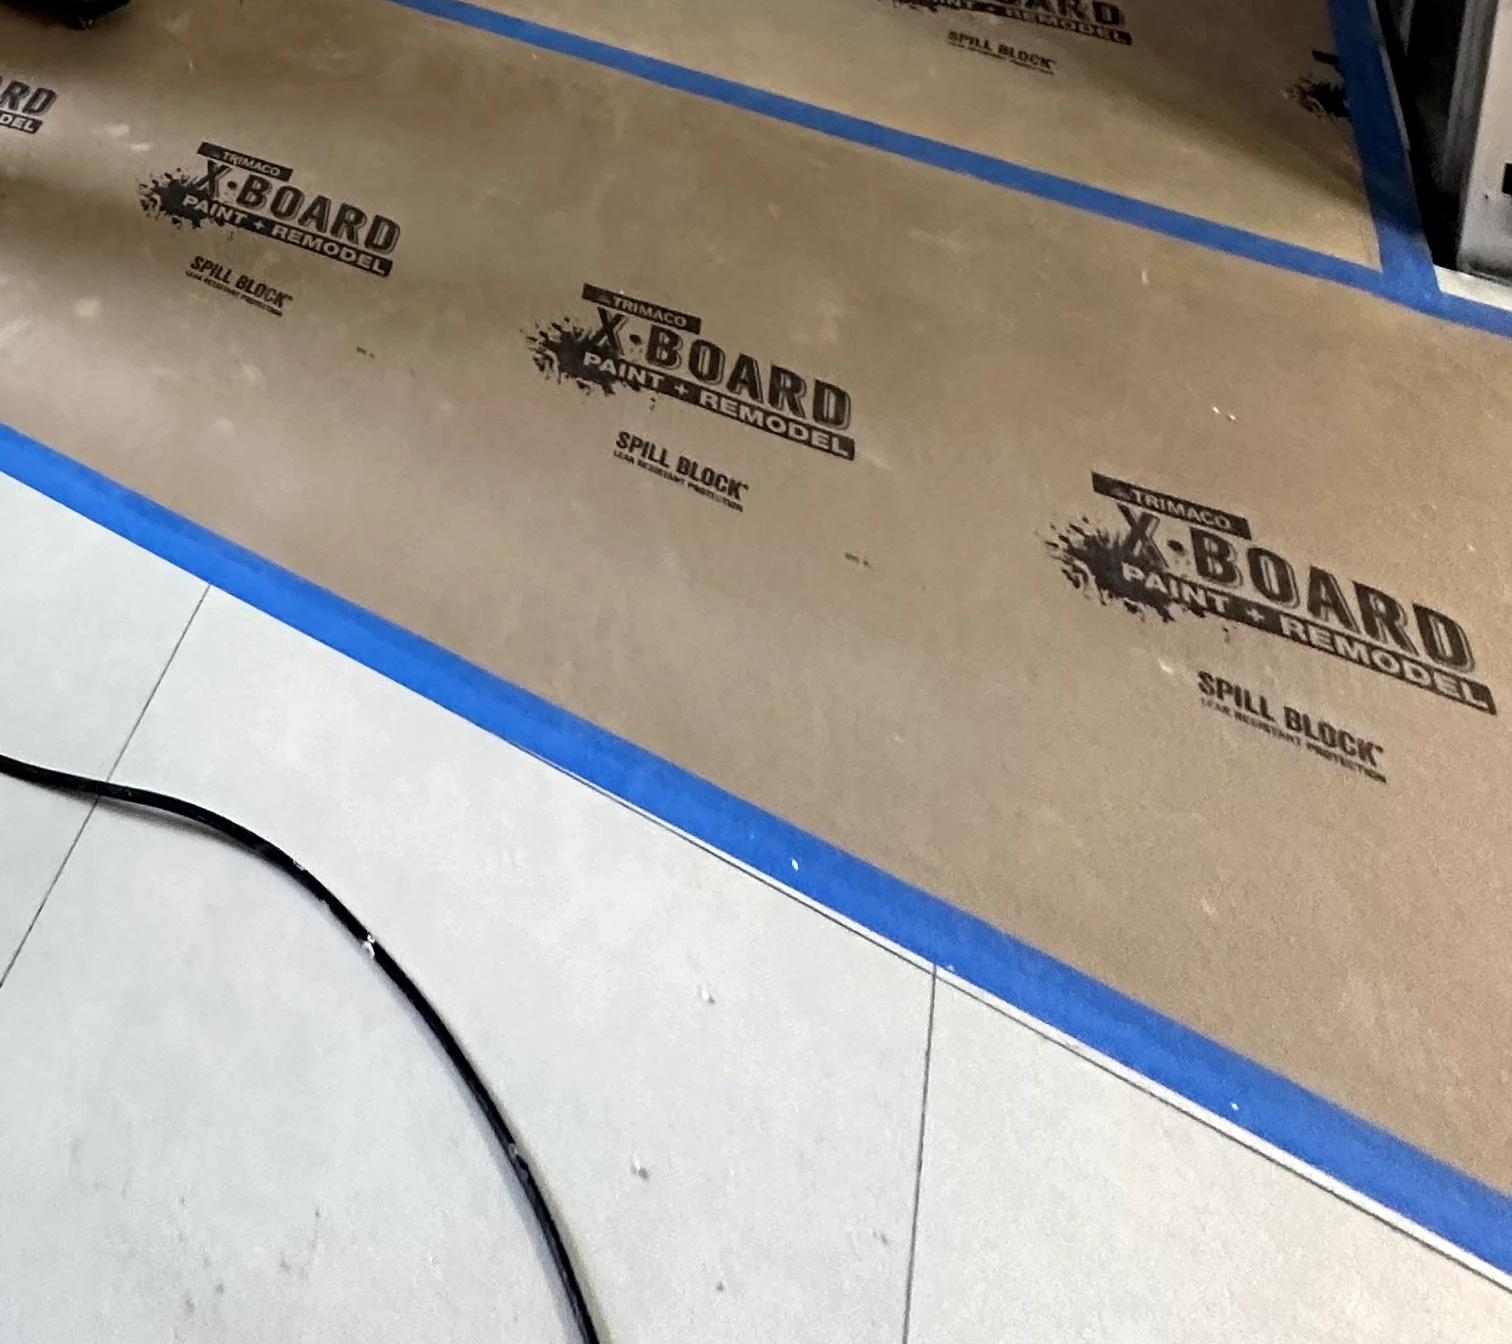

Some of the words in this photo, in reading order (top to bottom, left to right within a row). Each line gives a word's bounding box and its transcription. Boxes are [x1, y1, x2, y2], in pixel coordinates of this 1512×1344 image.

[222, 150, 281, 176] TRIMACO
[182, 194, 248, 224] PAINT
[271, 223, 387, 275] REMODEL
[190, 255, 231, 285] SPILL
[612, 296, 688, 328] TRIMACO
[583, 352, 665, 390] PAINT
[698, 391, 850, 458] REMODEL
[616, 430, 670, 468] SPILL
[1130, 488, 1232, 531] TRIMACO
[1122, 562, 1230, 614] PAINT
[1278, 613, 1489, 712] REMODEL
[1198, 671, 1276, 723] SPILL
